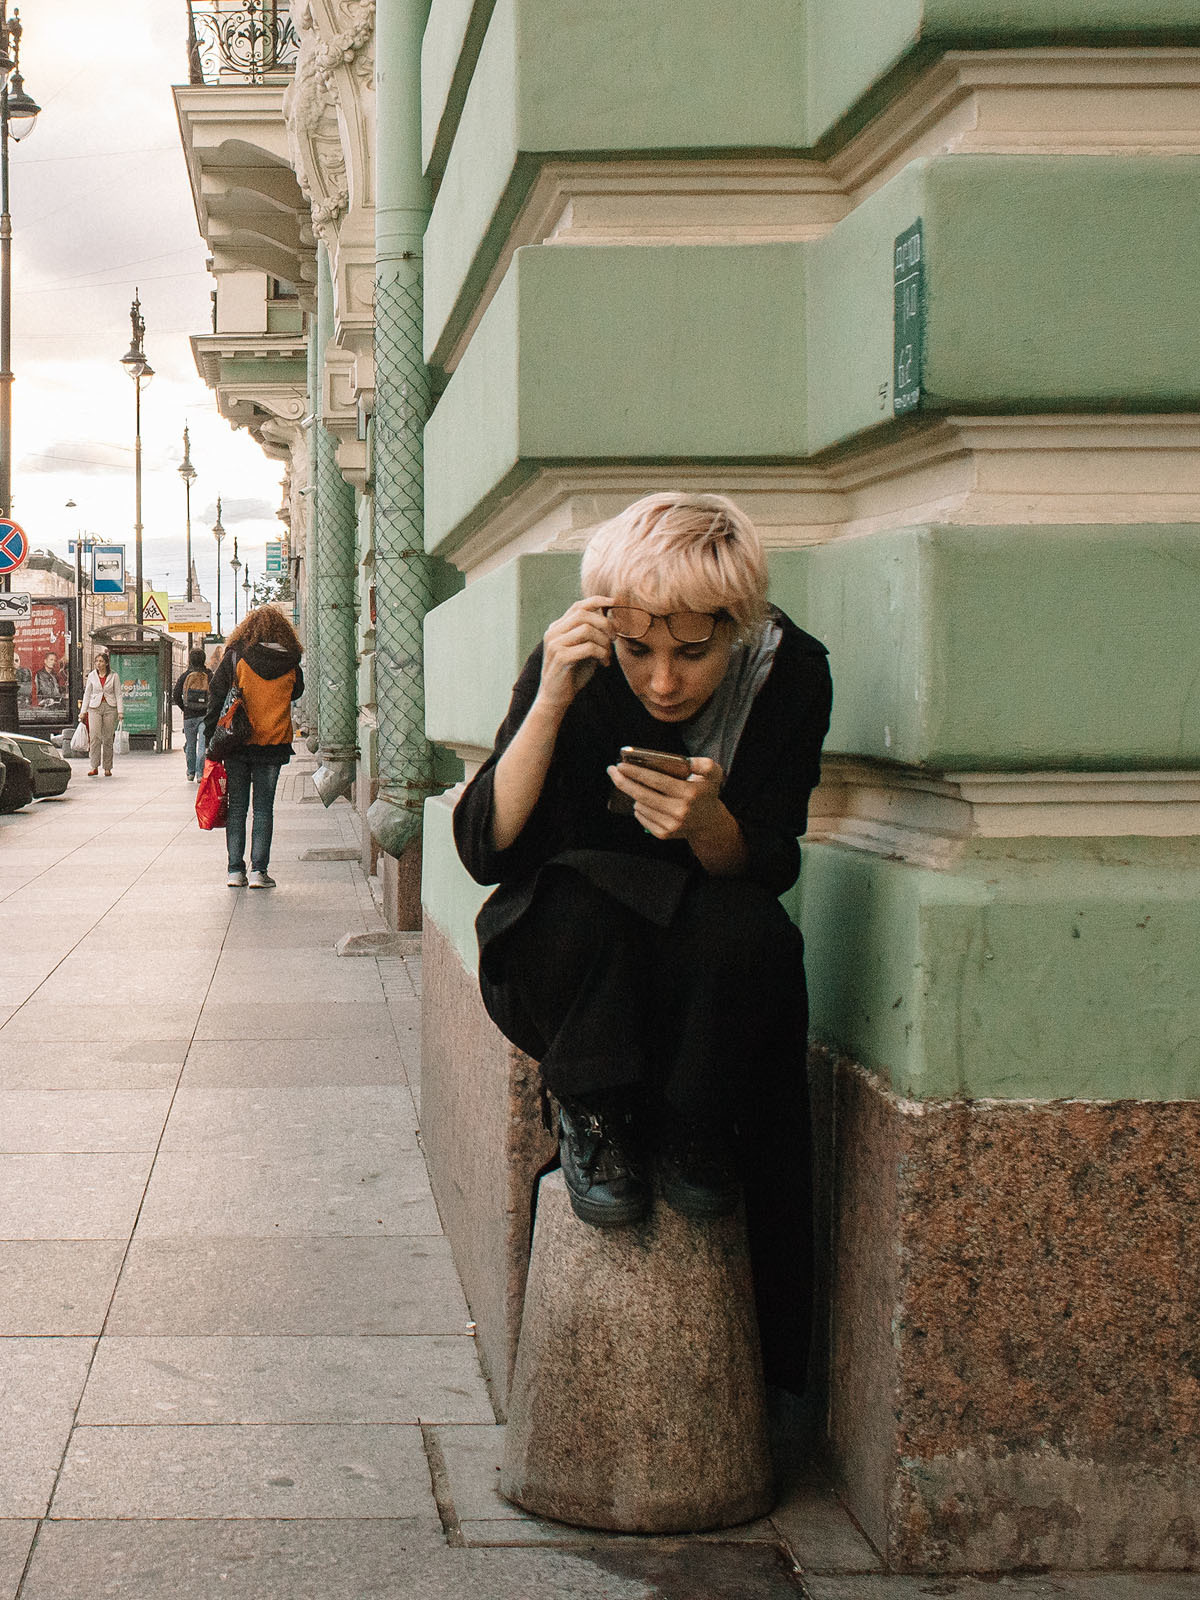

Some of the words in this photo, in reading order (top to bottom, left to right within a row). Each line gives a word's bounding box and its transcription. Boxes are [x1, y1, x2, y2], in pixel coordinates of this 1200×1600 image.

[14, 619, 32, 628] pple
[34, 617, 57, 626] Music
[120, 683, 150, 691] football
